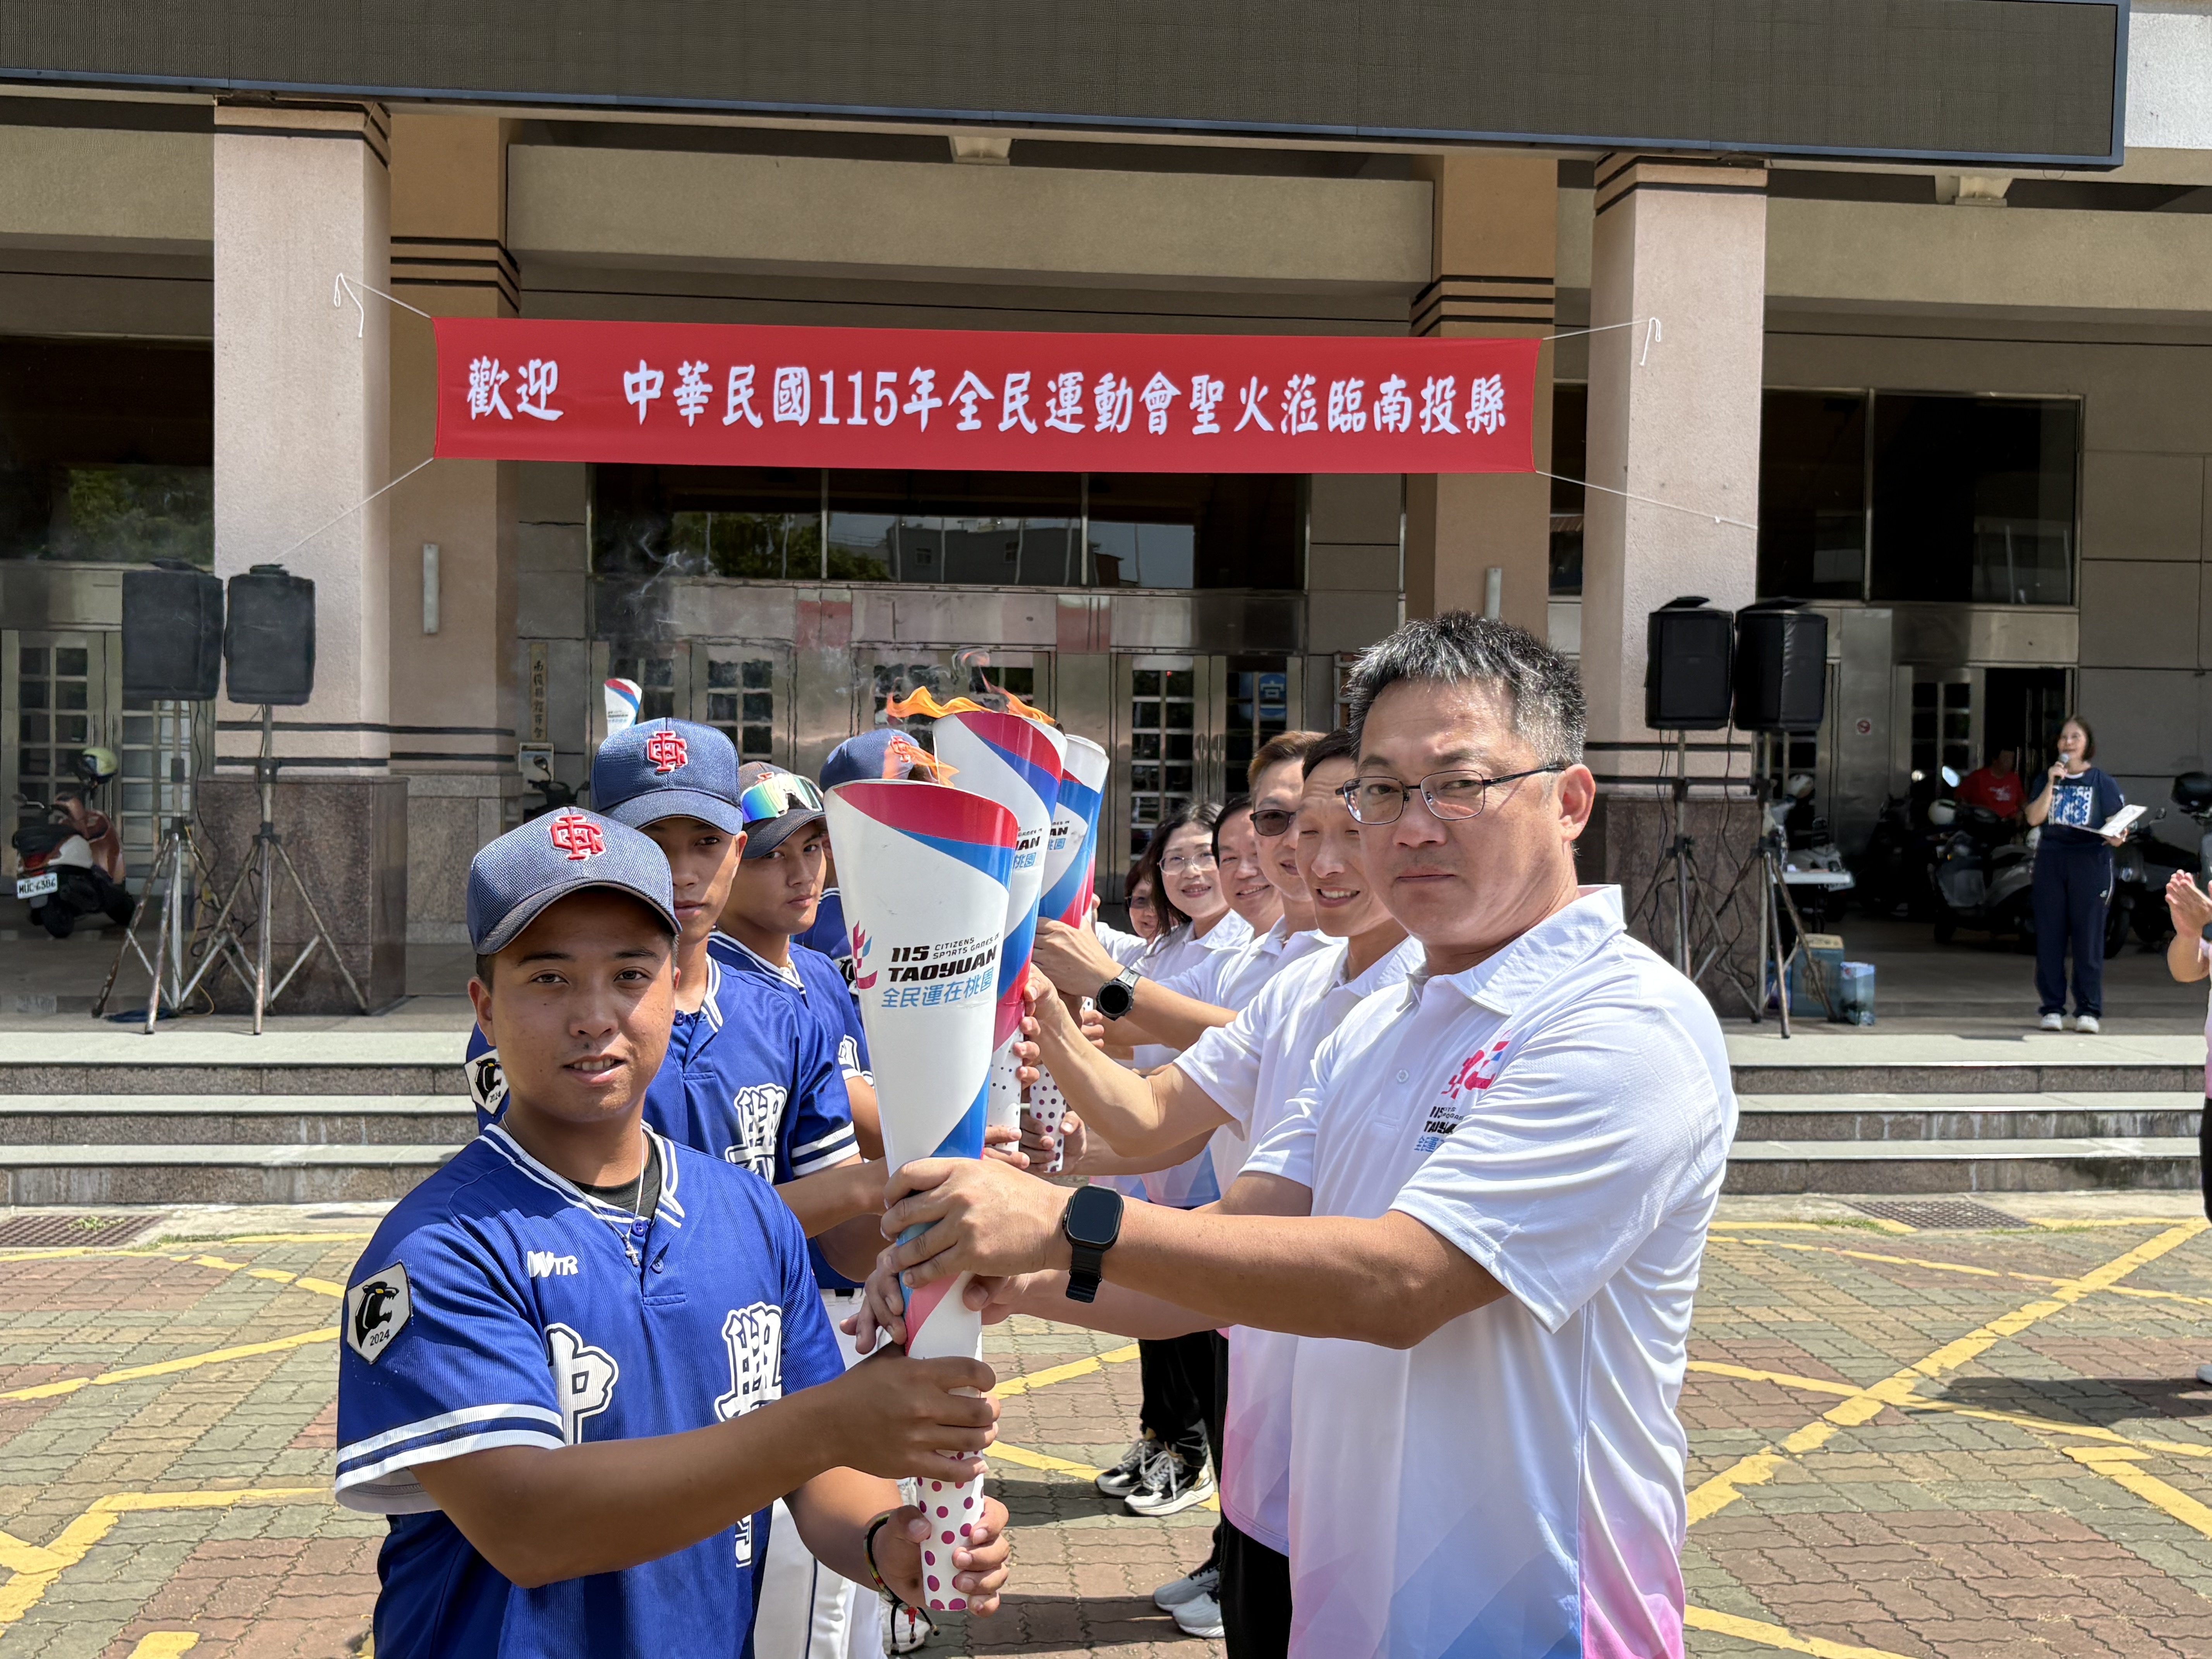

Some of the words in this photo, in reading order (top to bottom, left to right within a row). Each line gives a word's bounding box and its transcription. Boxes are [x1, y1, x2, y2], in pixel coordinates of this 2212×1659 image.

[467, 355, 564, 421] 歡迎
[623, 359, 1506, 436] 中華民國115年全民運動會聖火蒞臨南投縣
[888, 944, 998, 982] TAOYUAN
[891, 945, 930, 962] 115
[935, 937, 975, 951] CITIZENS
[933, 947, 968, 959] SPORTS
[881, 967, 994, 1008] 全民運在桃園
[369, 1329, 390, 1346] 2024
